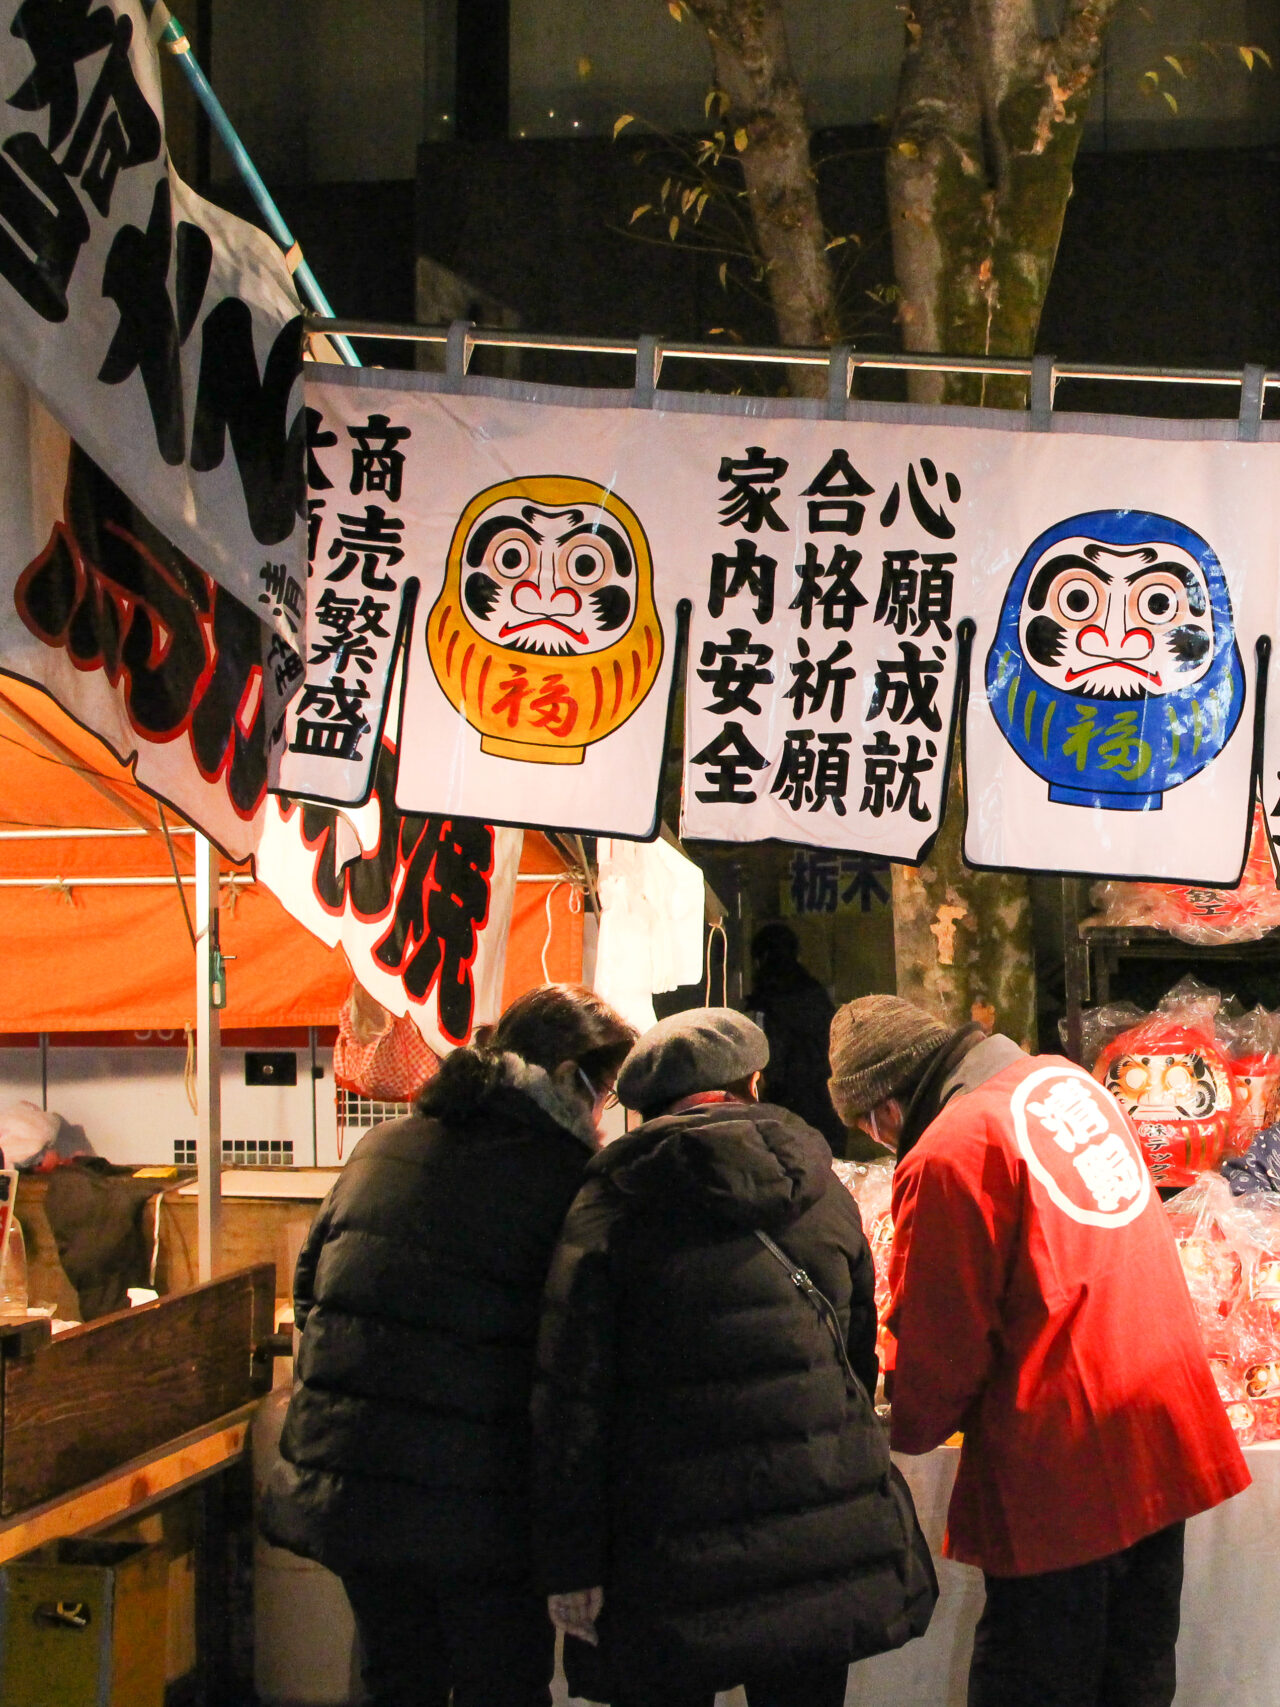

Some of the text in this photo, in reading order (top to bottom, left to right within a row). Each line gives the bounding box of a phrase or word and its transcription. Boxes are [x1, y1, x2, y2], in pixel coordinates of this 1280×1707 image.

[290, 413, 411, 761] 商売繁盛
[490, 663, 580, 738] 福
[689, 446, 790, 805] 家内安全
[769, 448, 875, 817] 合格祈願
[859, 457, 962, 822] 心願成就
[1061, 703, 1153, 781] 福
